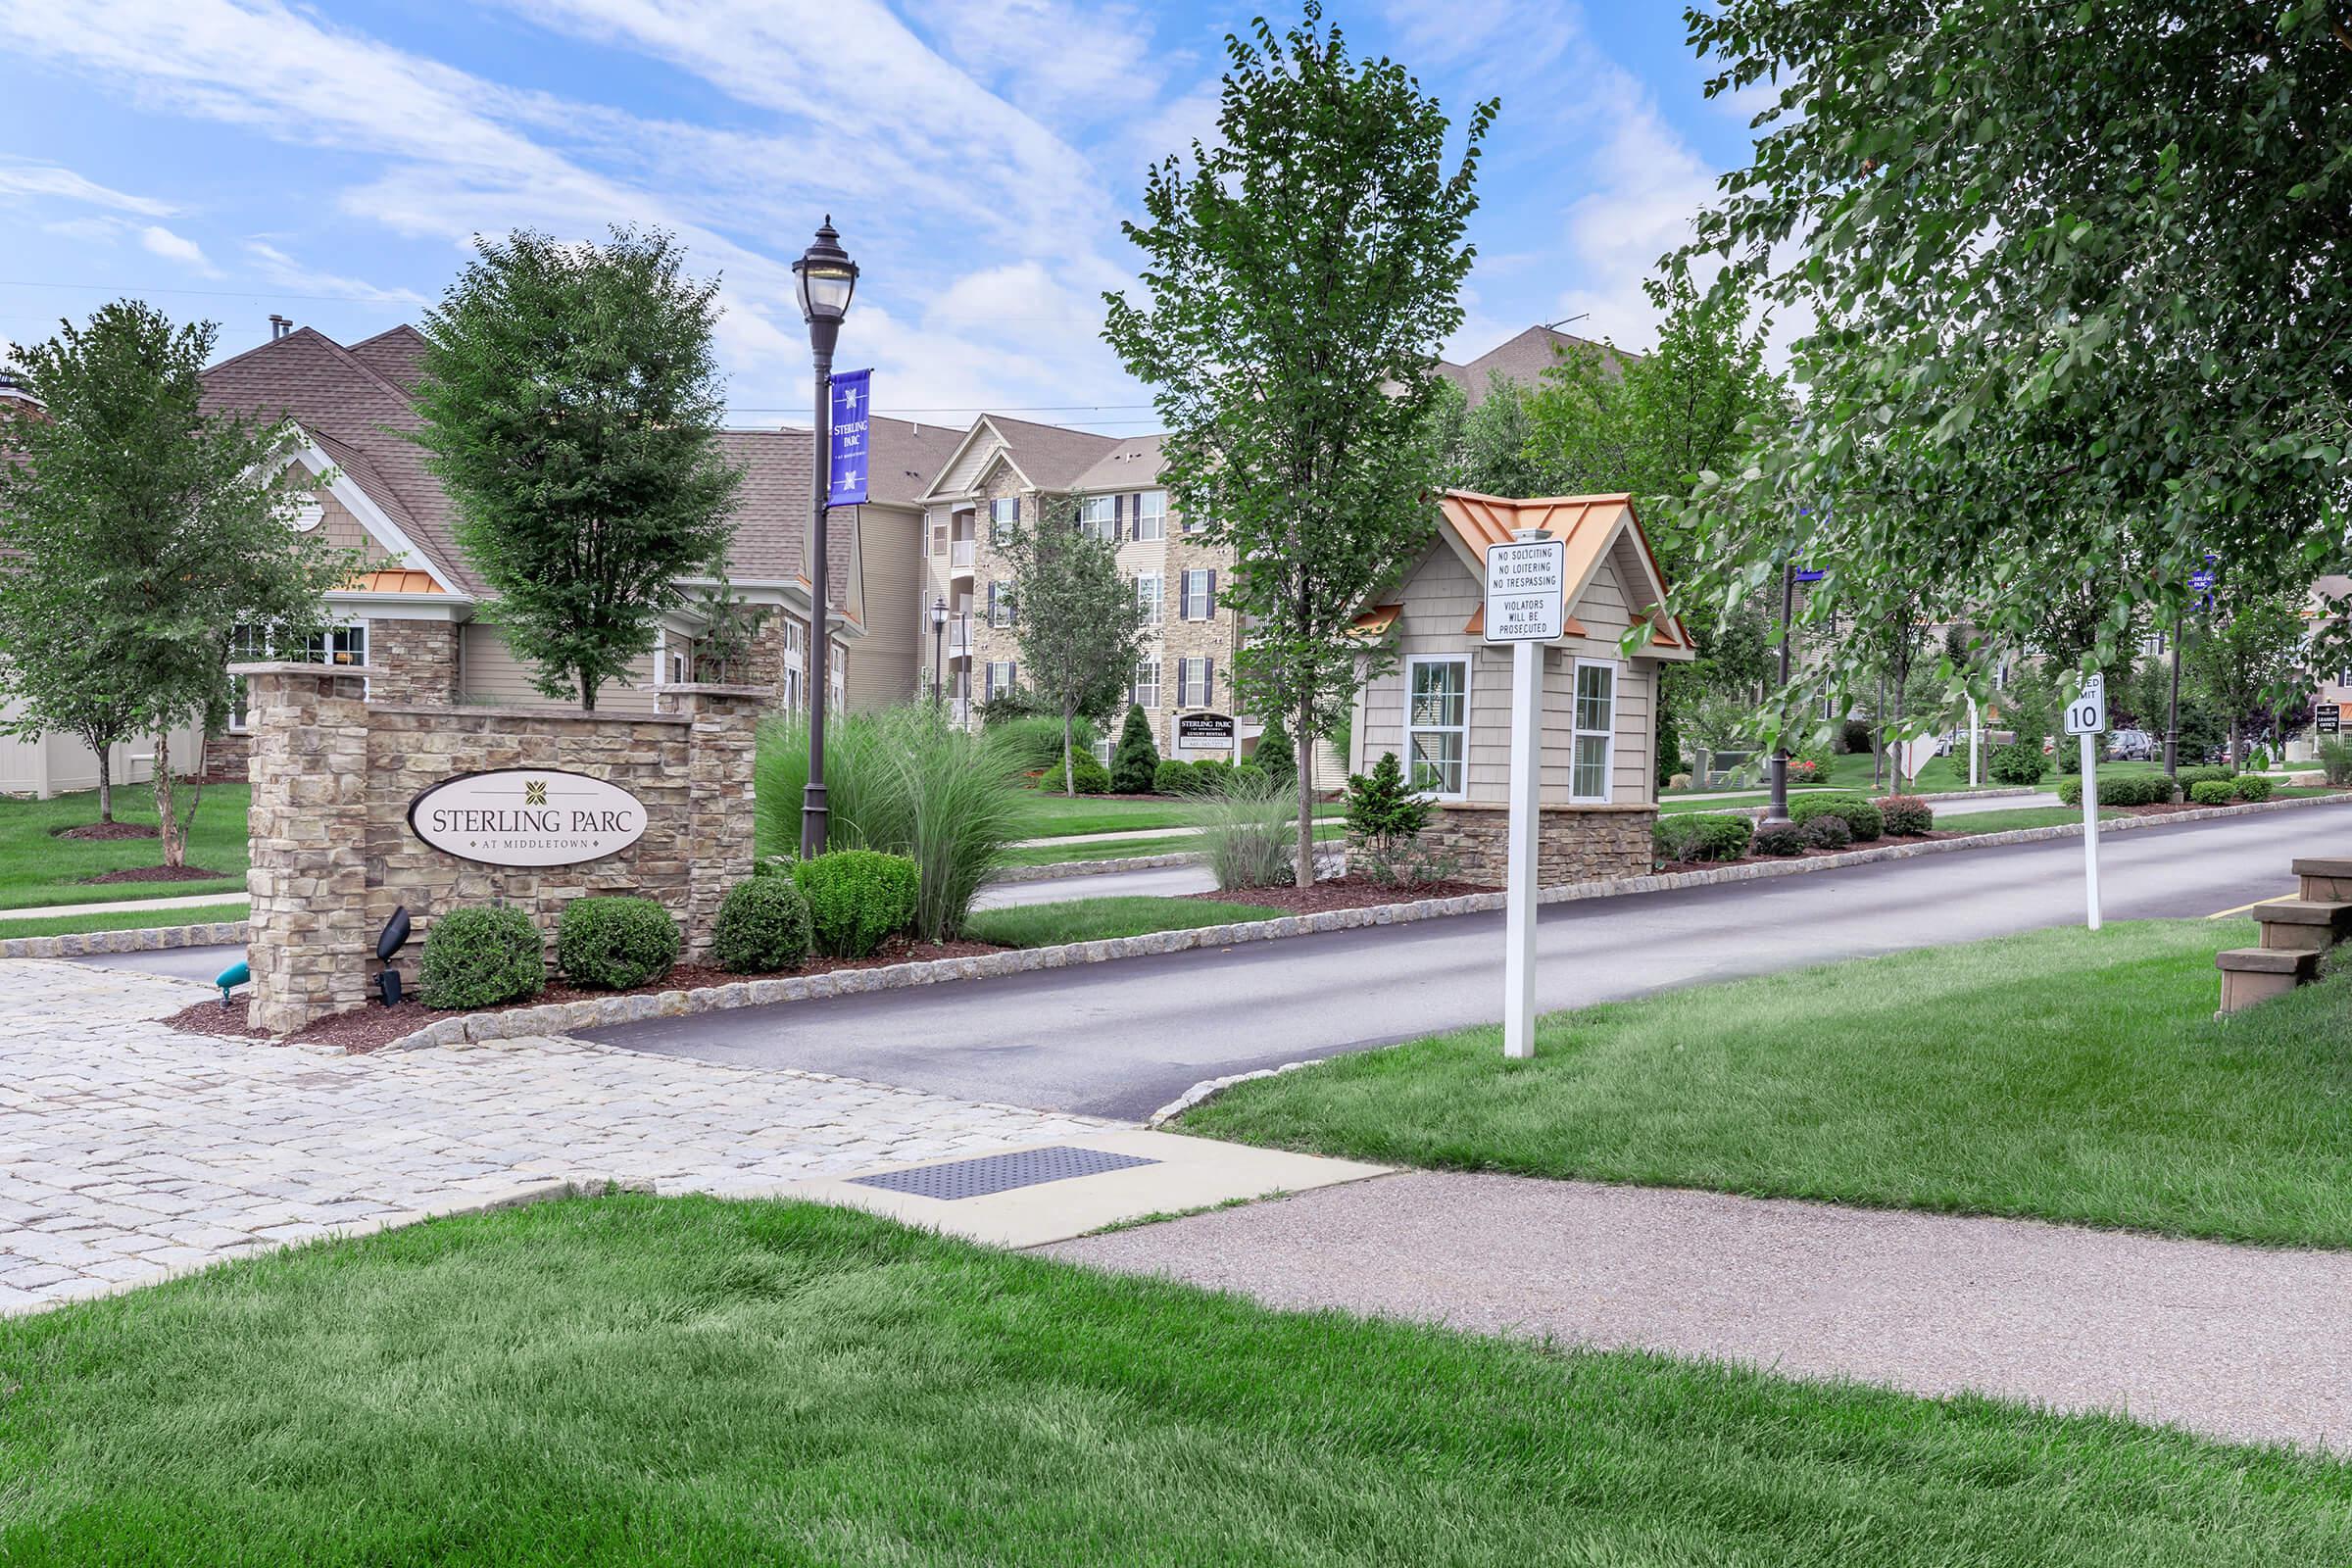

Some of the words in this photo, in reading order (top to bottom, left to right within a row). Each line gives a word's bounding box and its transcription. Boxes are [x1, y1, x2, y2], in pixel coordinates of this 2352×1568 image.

[834, 420, 867, 435] STERLING
[844, 435, 859, 447] PARC
[1498, 552, 1508, 561] NO
[1512, 549, 1552, 560] SOLICITING
[1499, 565, 1509, 574] NO
[1513, 563, 1550, 573] LOITERING
[1507, 576, 1556, 587] TRESPASSING
[1504, 600, 1544, 610] VIOLATORS
[1509, 613, 1525, 622] WILL
[1529, 612, 1539, 621] BE
[1499, 623, 1546, 634] PROSECUTED
[2073, 707, 2096, 728] 10
[432, 808, 561, 833] STERLING
[572, 809, 632, 833] PARC
[482, 840, 498, 849] AT
[504, 840, 589, 849] MIDDLETOWN
